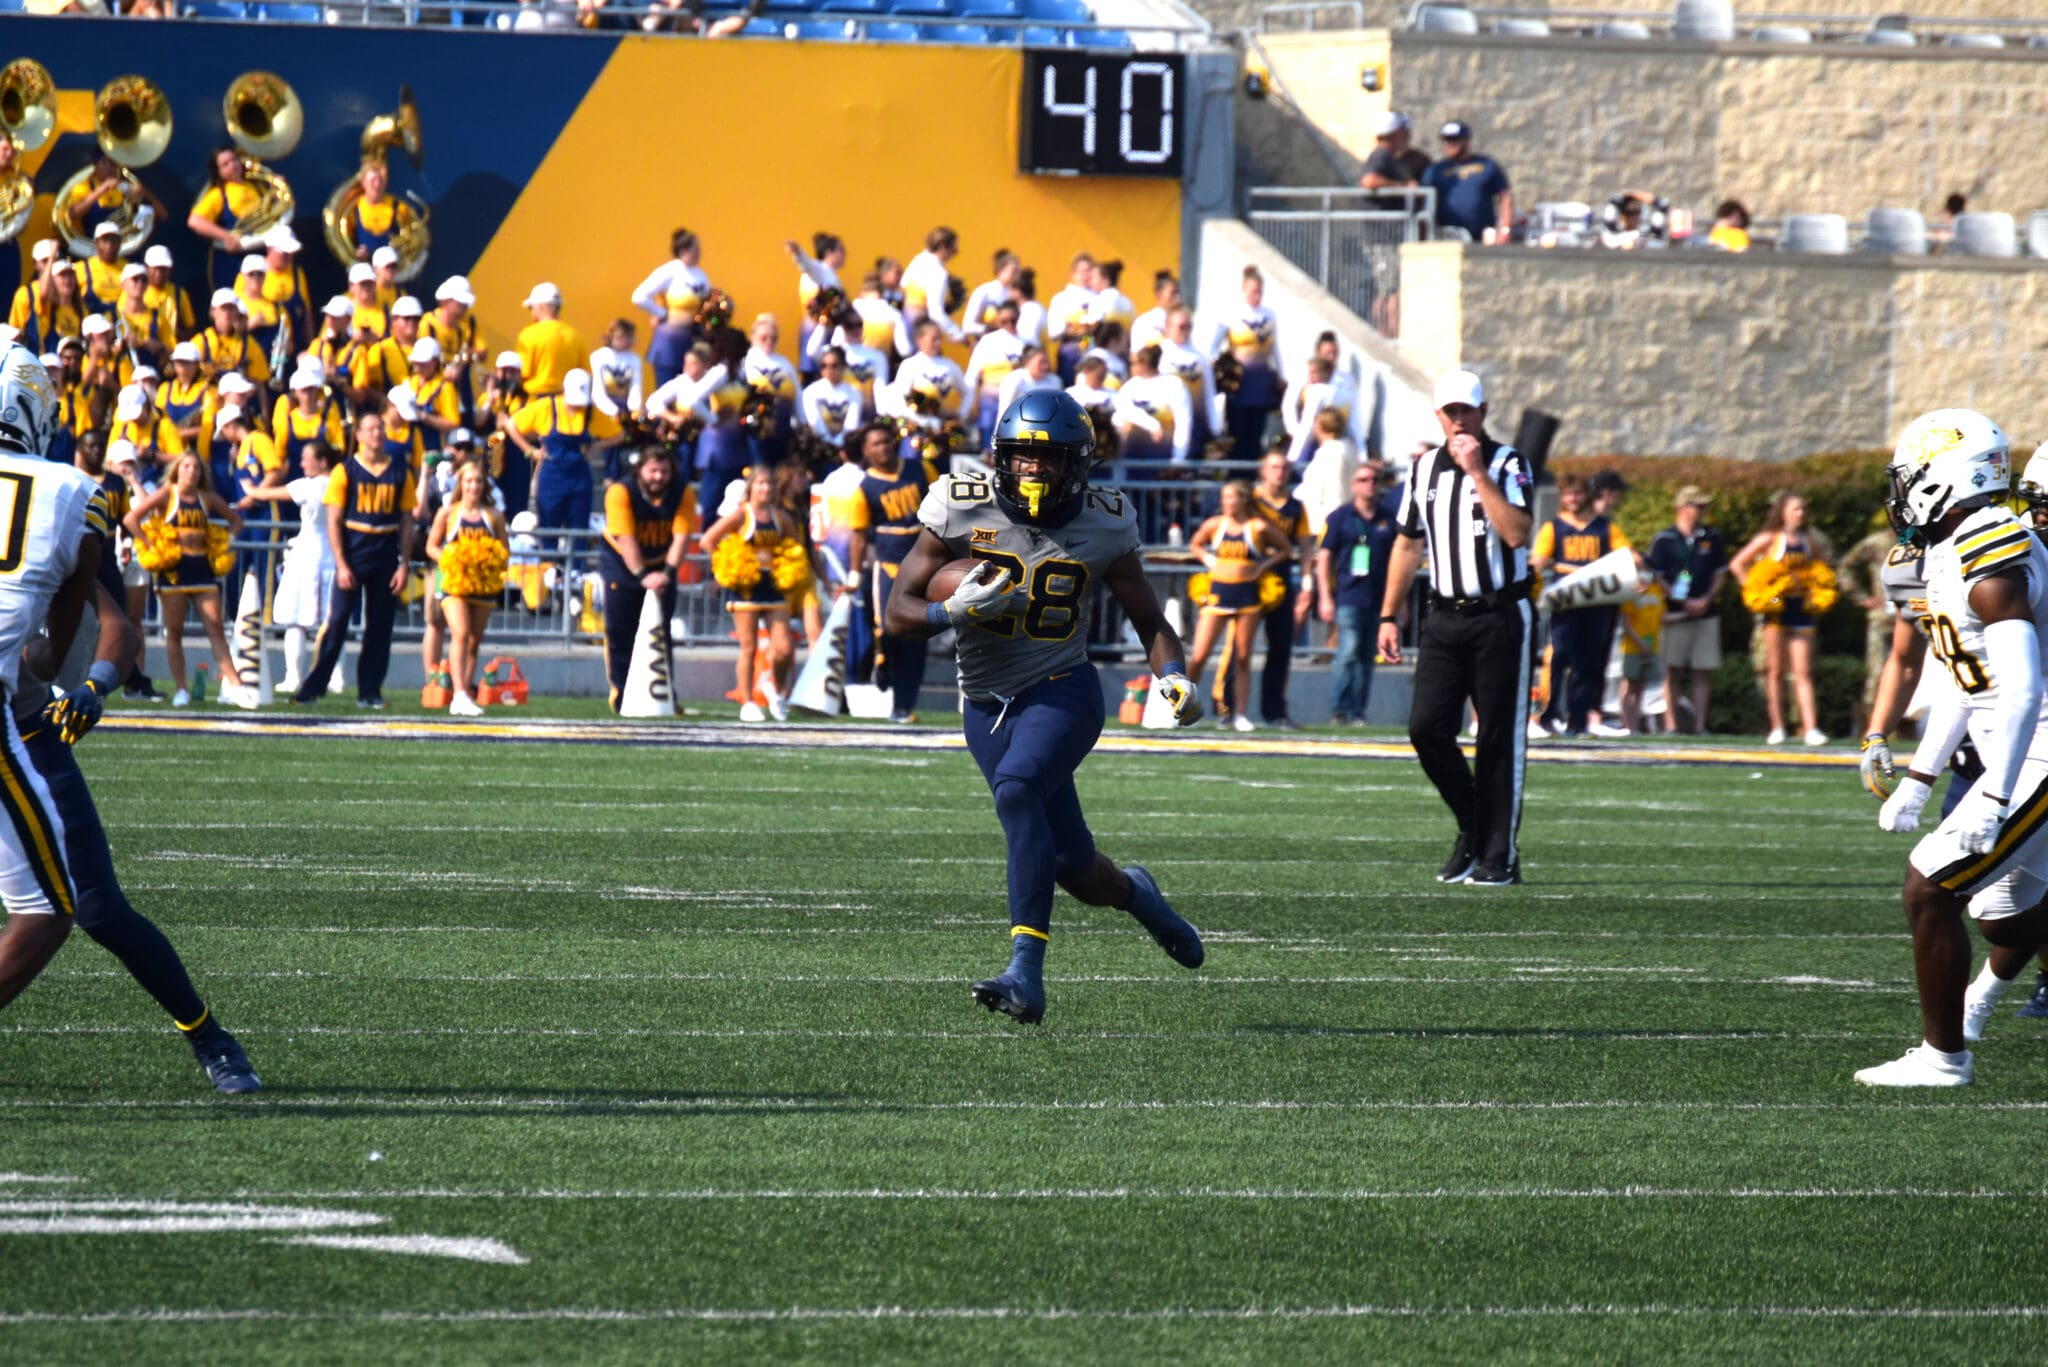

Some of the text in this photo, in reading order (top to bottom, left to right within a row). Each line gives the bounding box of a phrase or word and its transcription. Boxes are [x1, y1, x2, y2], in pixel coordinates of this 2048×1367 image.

[1043, 61, 1174, 164] 40
[969, 545, 1090, 642] 28
[1546, 572, 1622, 610] WVU
[649, 624, 670, 702] WVU
[824, 626, 847, 699] WVU
